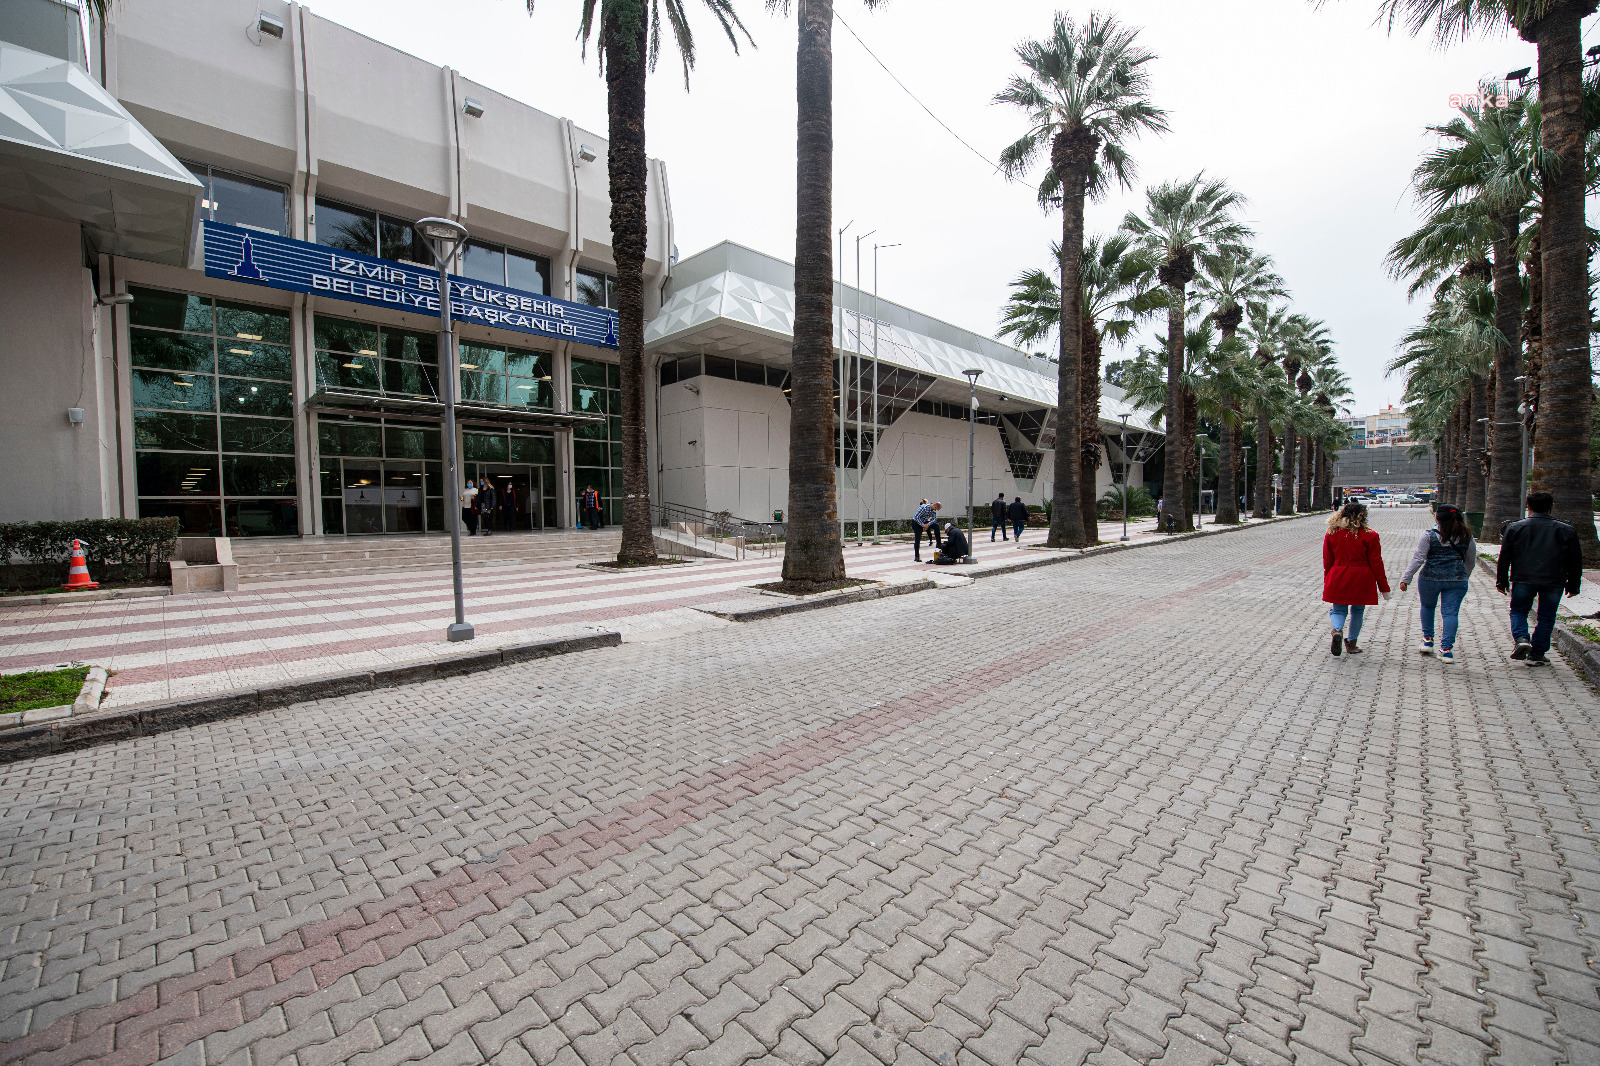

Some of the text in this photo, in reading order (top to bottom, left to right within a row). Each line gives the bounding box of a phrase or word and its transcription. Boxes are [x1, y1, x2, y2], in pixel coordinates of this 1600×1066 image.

[331, 253, 407, 285] İZMİR
[312, 274, 578, 337] BELEDİYE BAŞKANLIĞI
